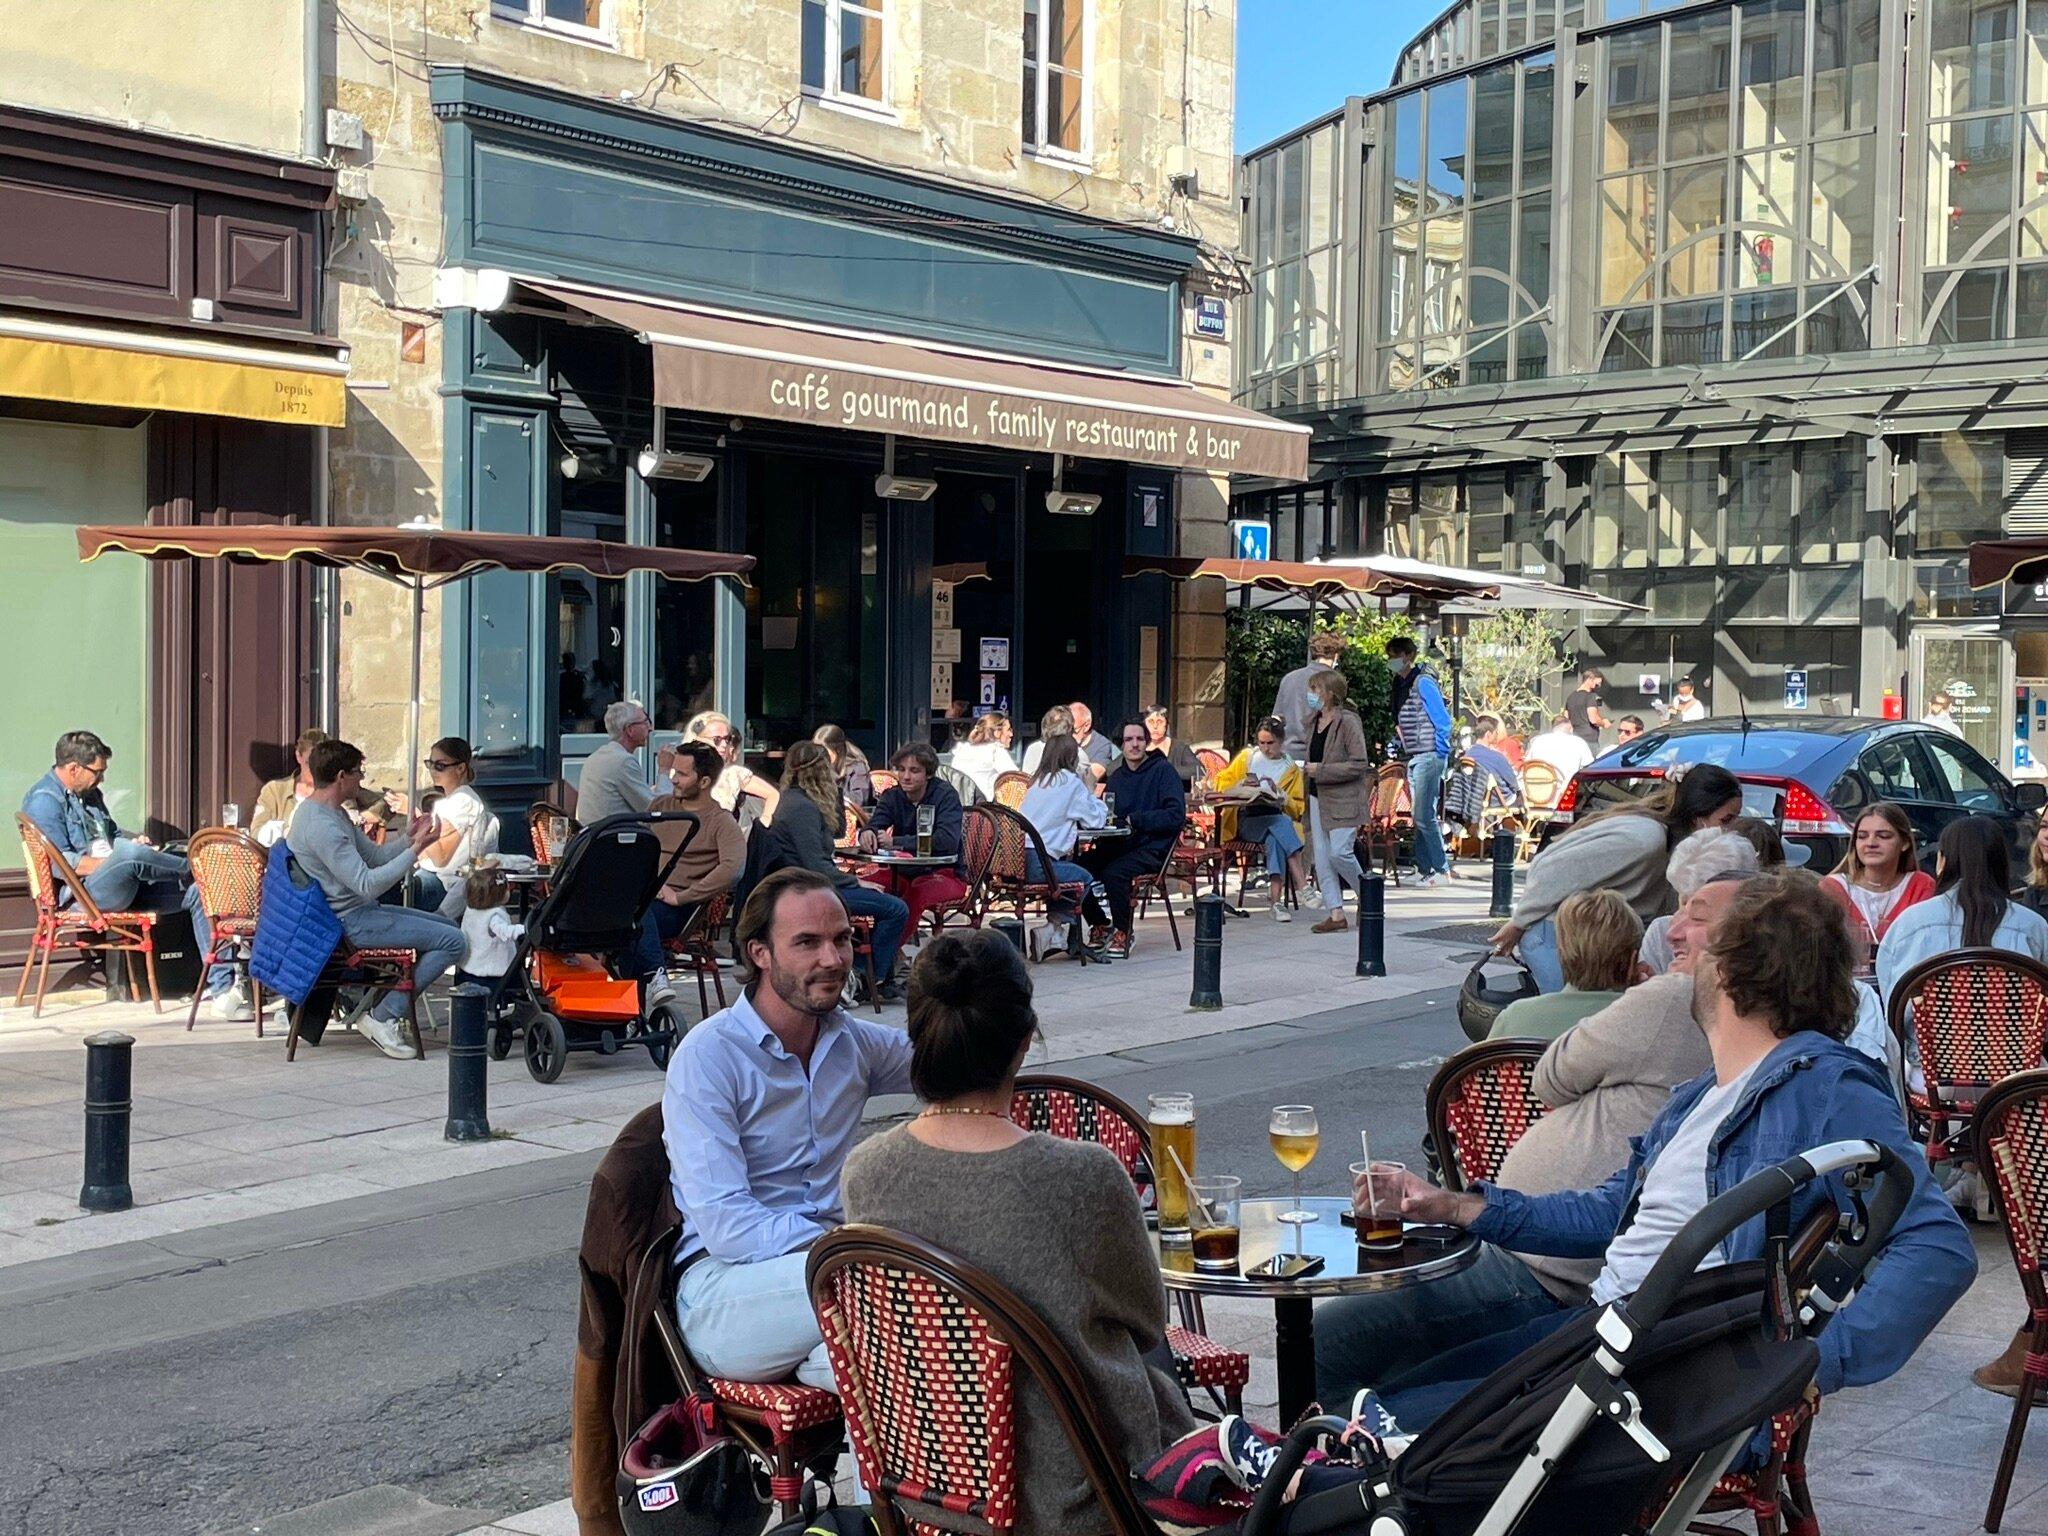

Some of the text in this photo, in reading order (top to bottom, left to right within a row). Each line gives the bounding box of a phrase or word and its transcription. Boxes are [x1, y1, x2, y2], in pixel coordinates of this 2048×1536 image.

[1203, 301, 1219, 314] RUE
[1198, 315, 1223, 330] BUFFON
[275, 381, 313, 397] Depuis
[282, 400, 308, 415] 1872
[770, 372, 1241, 460] café gourmand, family restaurant & bar
[936, 590, 949, 603] 46
[643, 1486, 672, 1508] 100%
